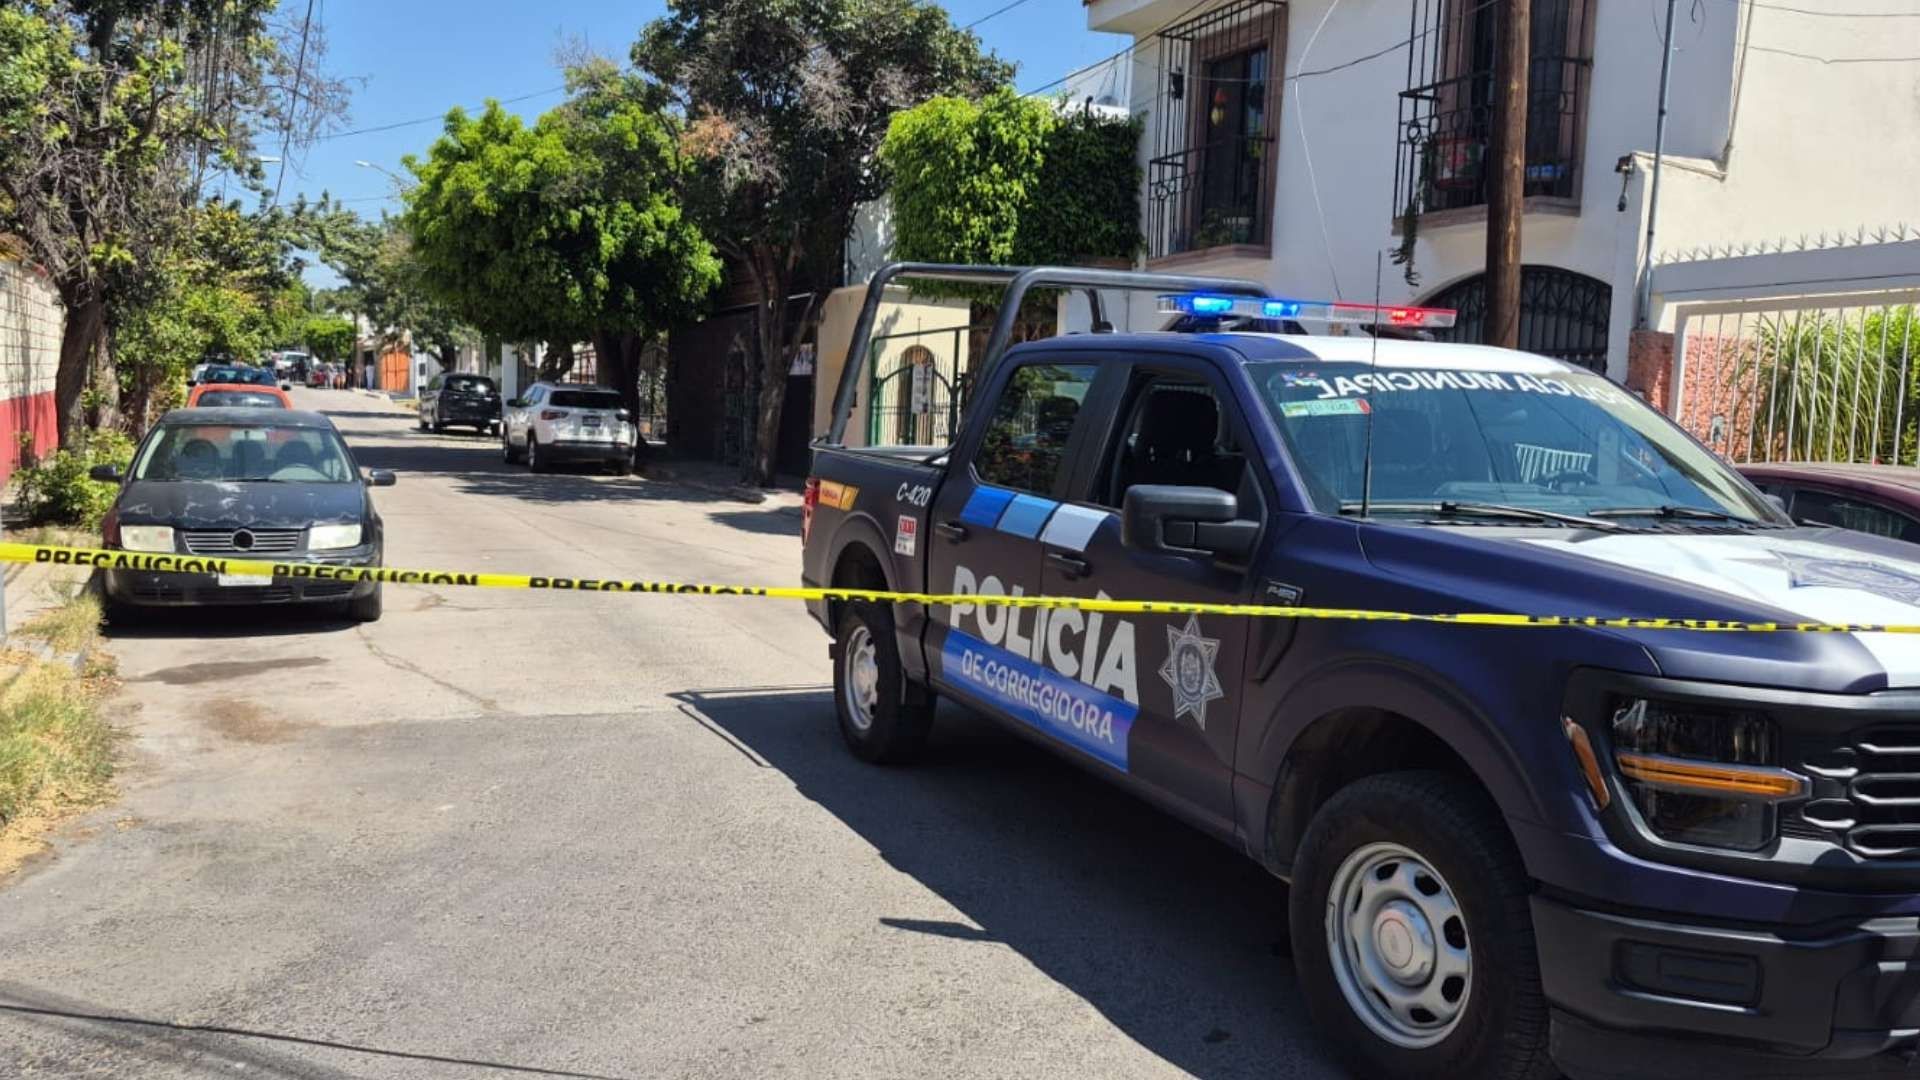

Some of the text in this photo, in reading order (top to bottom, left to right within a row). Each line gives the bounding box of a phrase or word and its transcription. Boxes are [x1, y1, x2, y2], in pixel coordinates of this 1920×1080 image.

[896, 482, 931, 507] C-420
[962, 649, 1114, 744] DE CORREGIDORA
